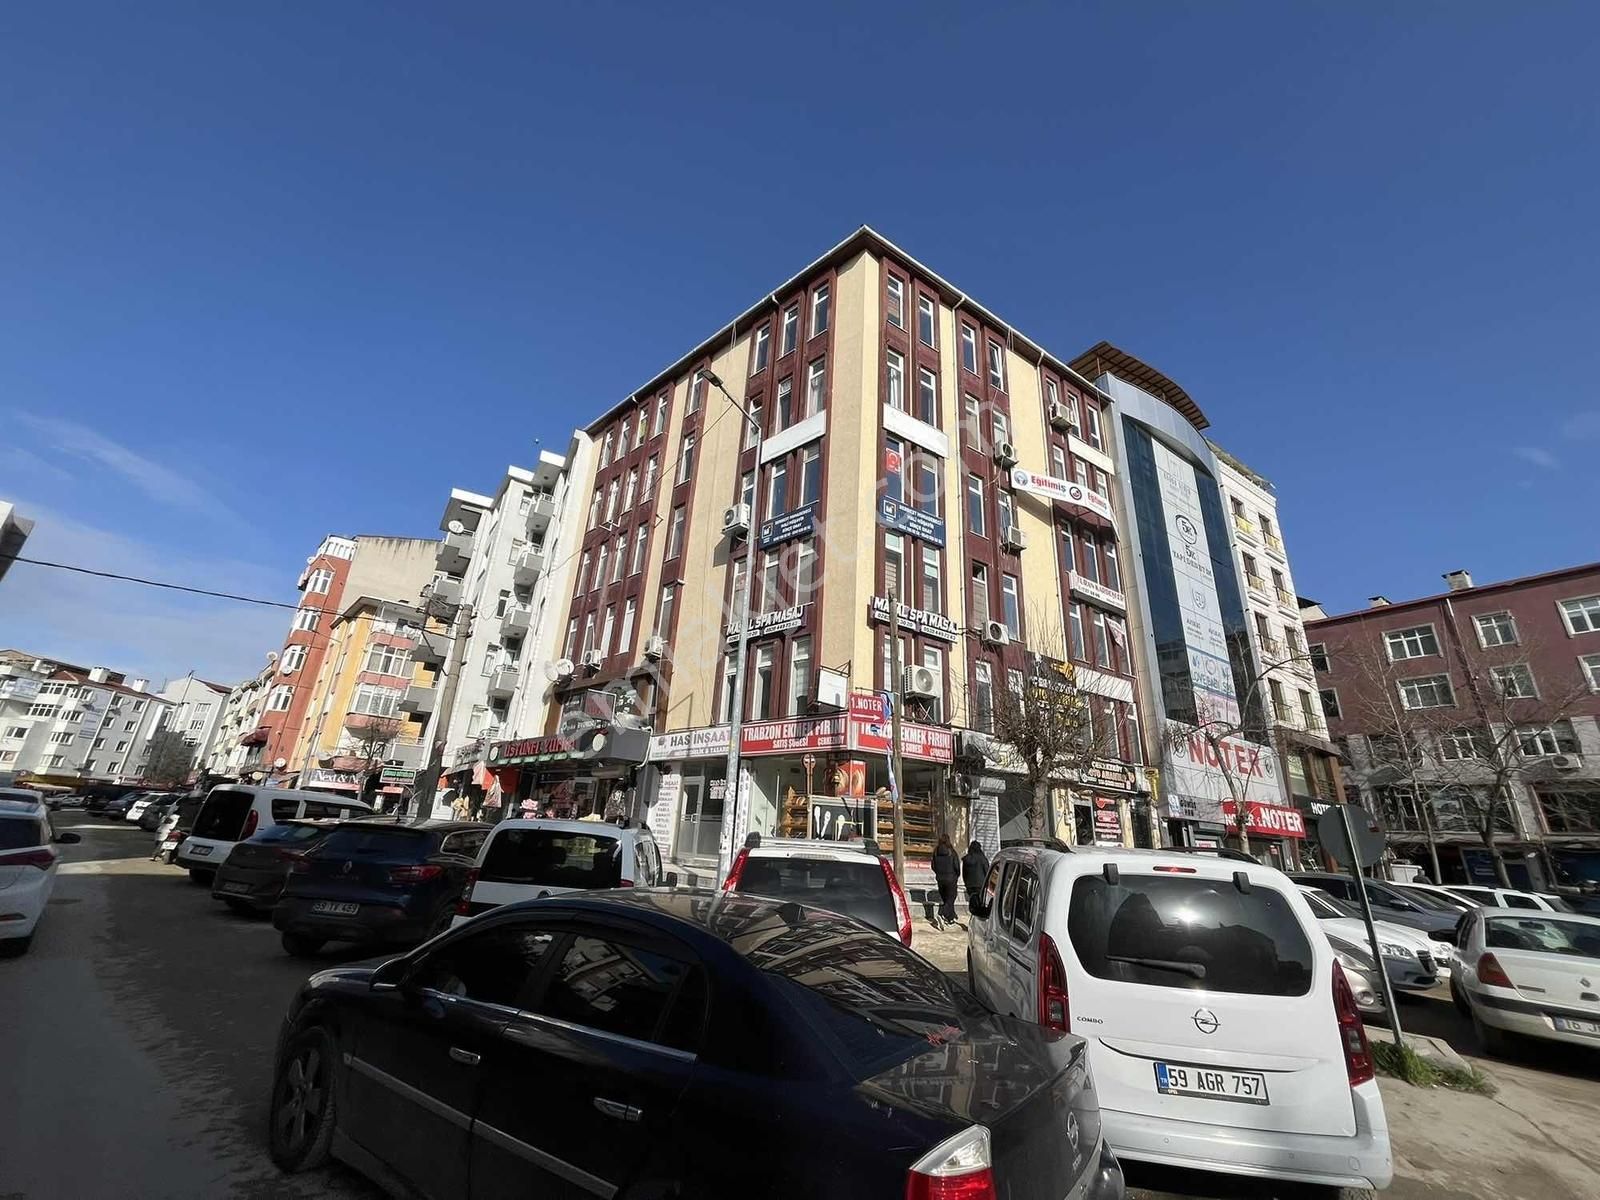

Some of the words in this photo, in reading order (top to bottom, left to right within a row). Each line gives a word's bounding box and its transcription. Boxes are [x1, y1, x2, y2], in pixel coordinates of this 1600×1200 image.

[755, 611, 775, 629] SPA
[772, 605, 803, 625] MASAJ
[873, 596, 908, 619] MAAL
[909, 609, 928, 624] SPA
[851, 696, 883, 712] 1.NOTER
[743, 724, 782, 742] TRABZON
[782, 721, 814, 738] EKMEK
[815, 718, 846, 736] FIRINI
[900, 726, 928, 745] EKMEK
[670, 734, 691, 747] HAS
[772, 739, 788, 749] SATIŞ
[788, 736, 808, 749] ŞUBESİ
[1188, 735, 1264, 778] NOTER
[315, 770, 338, 782] Next
[1076, 1016, 1103, 1025] COMBO
[1567, 1020, 1581, 1030] 16
[1589, 1023, 1600, 1033] J
[1168, 1068, 1188, 1088] 59
[1197, 1071, 1226, 1093] AGR
[1232, 1075, 1260, 1097] 757
